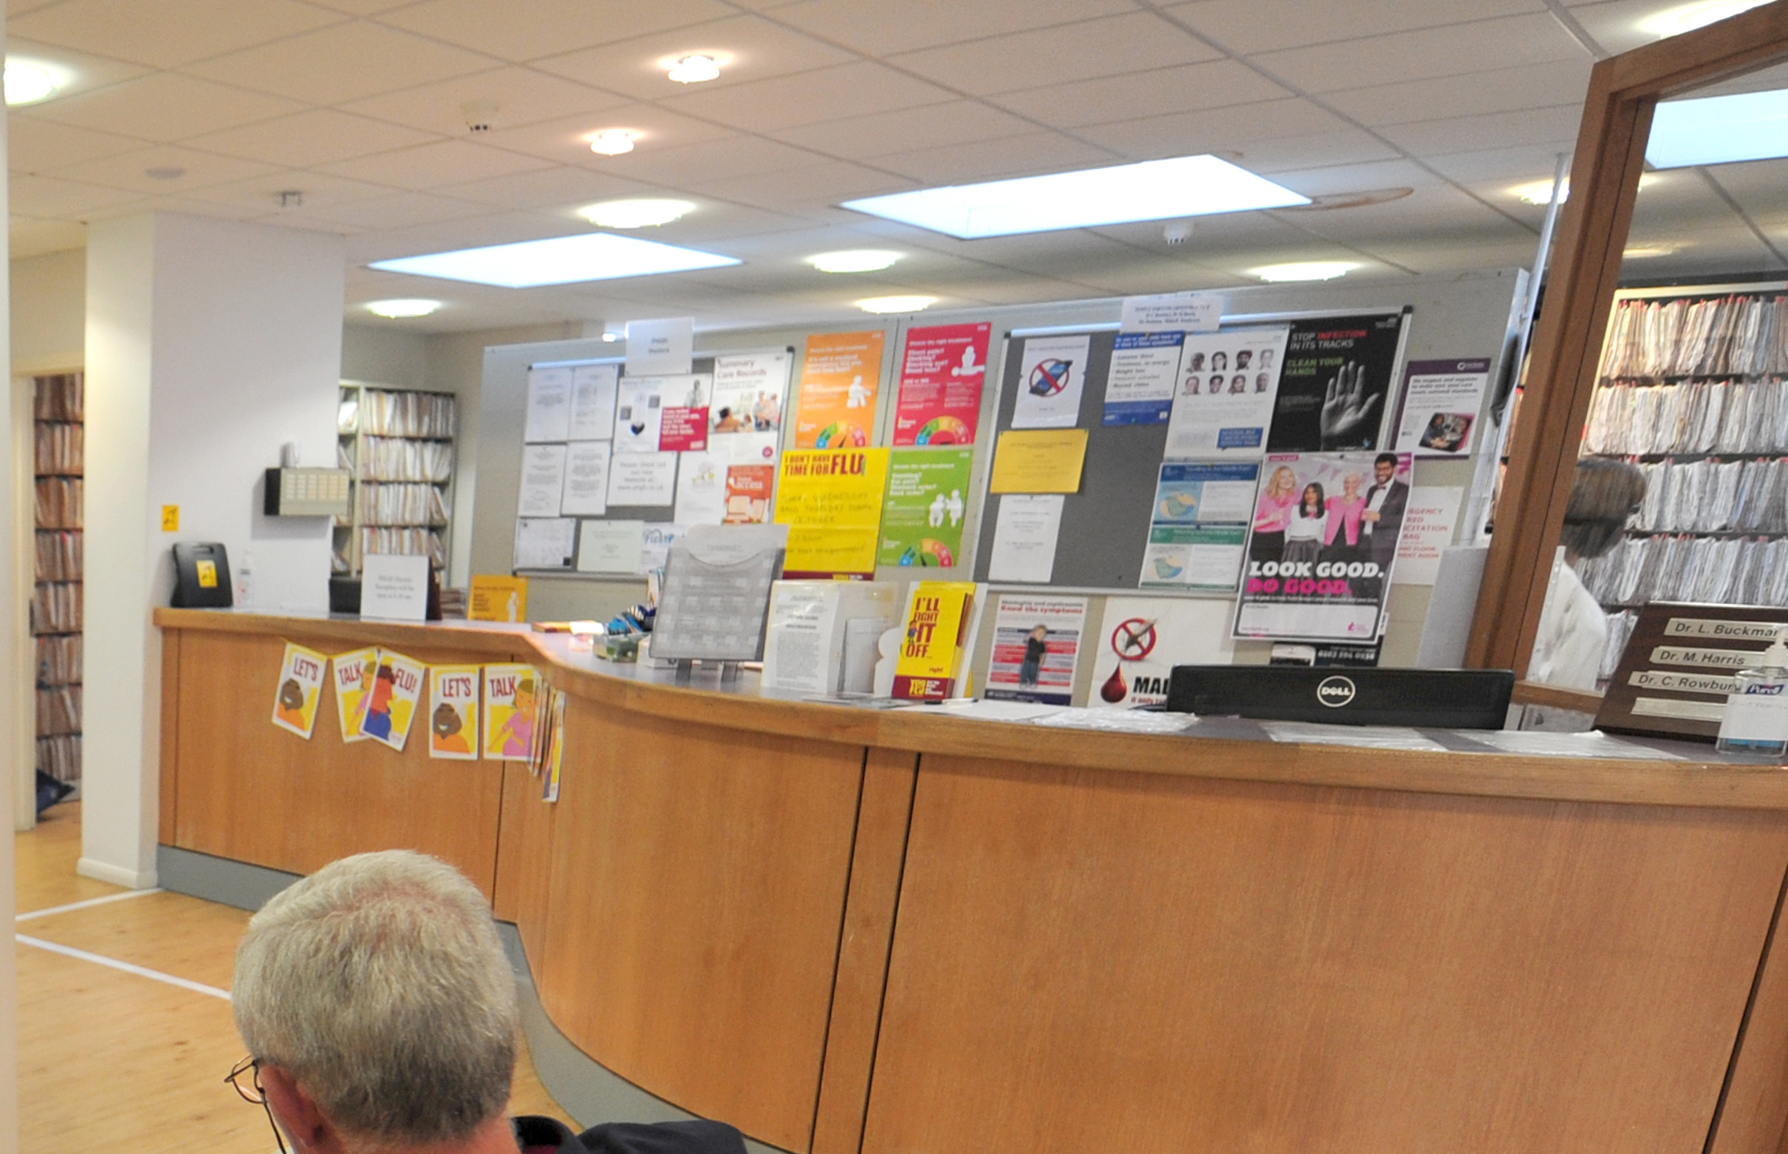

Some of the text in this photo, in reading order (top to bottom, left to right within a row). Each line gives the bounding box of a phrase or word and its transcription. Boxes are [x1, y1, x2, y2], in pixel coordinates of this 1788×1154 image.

[1290, 339, 1354, 350] IN ITS TRACKS
[1291, 332, 1316, 342] STOP
[1286, 358, 1317, 367] CLEAN
[717, 368, 767, 379] Care Records
[785, 463, 831, 476] TIME FOR
[830, 454, 864, 476] FLU
[1249, 560, 1384, 578] LOOK GOOD.
[1247, 578, 1353, 595] DO GOOD.
[916, 597, 940, 612] I'LL
[1040, 606, 1083, 614] symptoms
[914, 612, 939, 623] FIGHT
[916, 623, 937, 643] IT
[1675, 622, 1694, 633] Dr.
[1698, 624, 1710, 634] L.
[1660, 650, 1746, 665] Dr. M. Harris
[293, 657, 319, 682] LET'S
[338, 660, 364, 686] TALK
[394, 667, 418, 694] FLU!
[442, 677, 472, 698] LET'S
[489, 676, 518, 698] TALK
[1133, 676, 1169, 696] MAL
[1638, 674, 1657, 686] Dr.
[1662, 676, 1676, 687] C.
[1321, 686, 1351, 696] DELL
